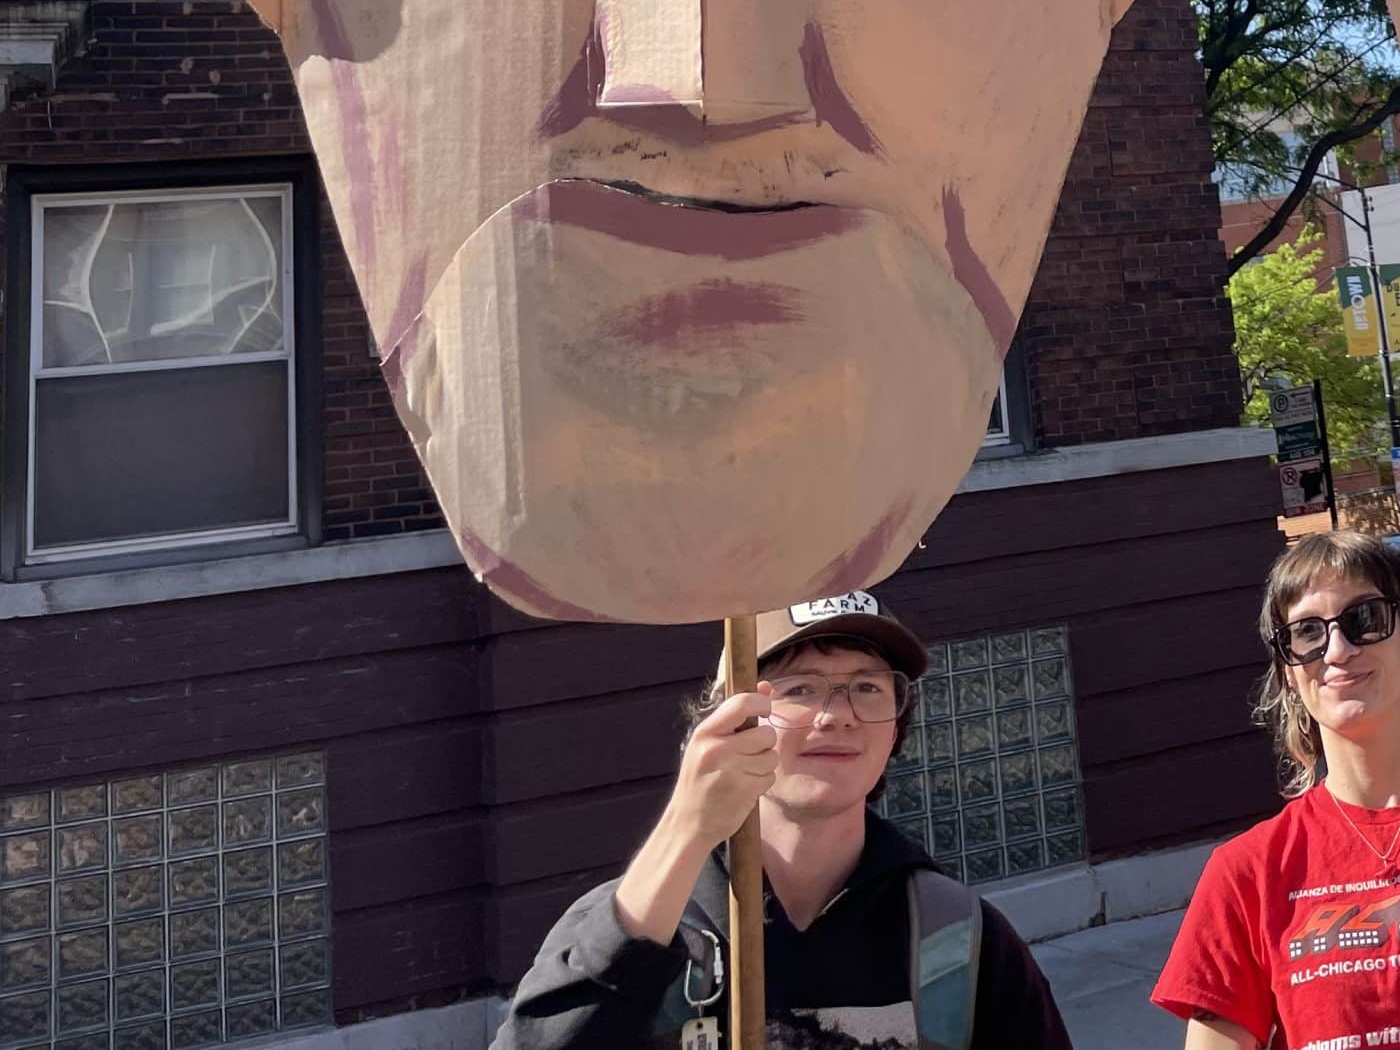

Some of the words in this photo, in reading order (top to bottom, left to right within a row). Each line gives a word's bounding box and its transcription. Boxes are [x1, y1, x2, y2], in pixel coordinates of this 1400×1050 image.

[809, 599, 865, 613] FARM
[1288, 887, 1328, 901] ALIANZA
[1330, 884, 1344, 893] DE
[1290, 957, 1386, 986] ALL-CHICAGO
